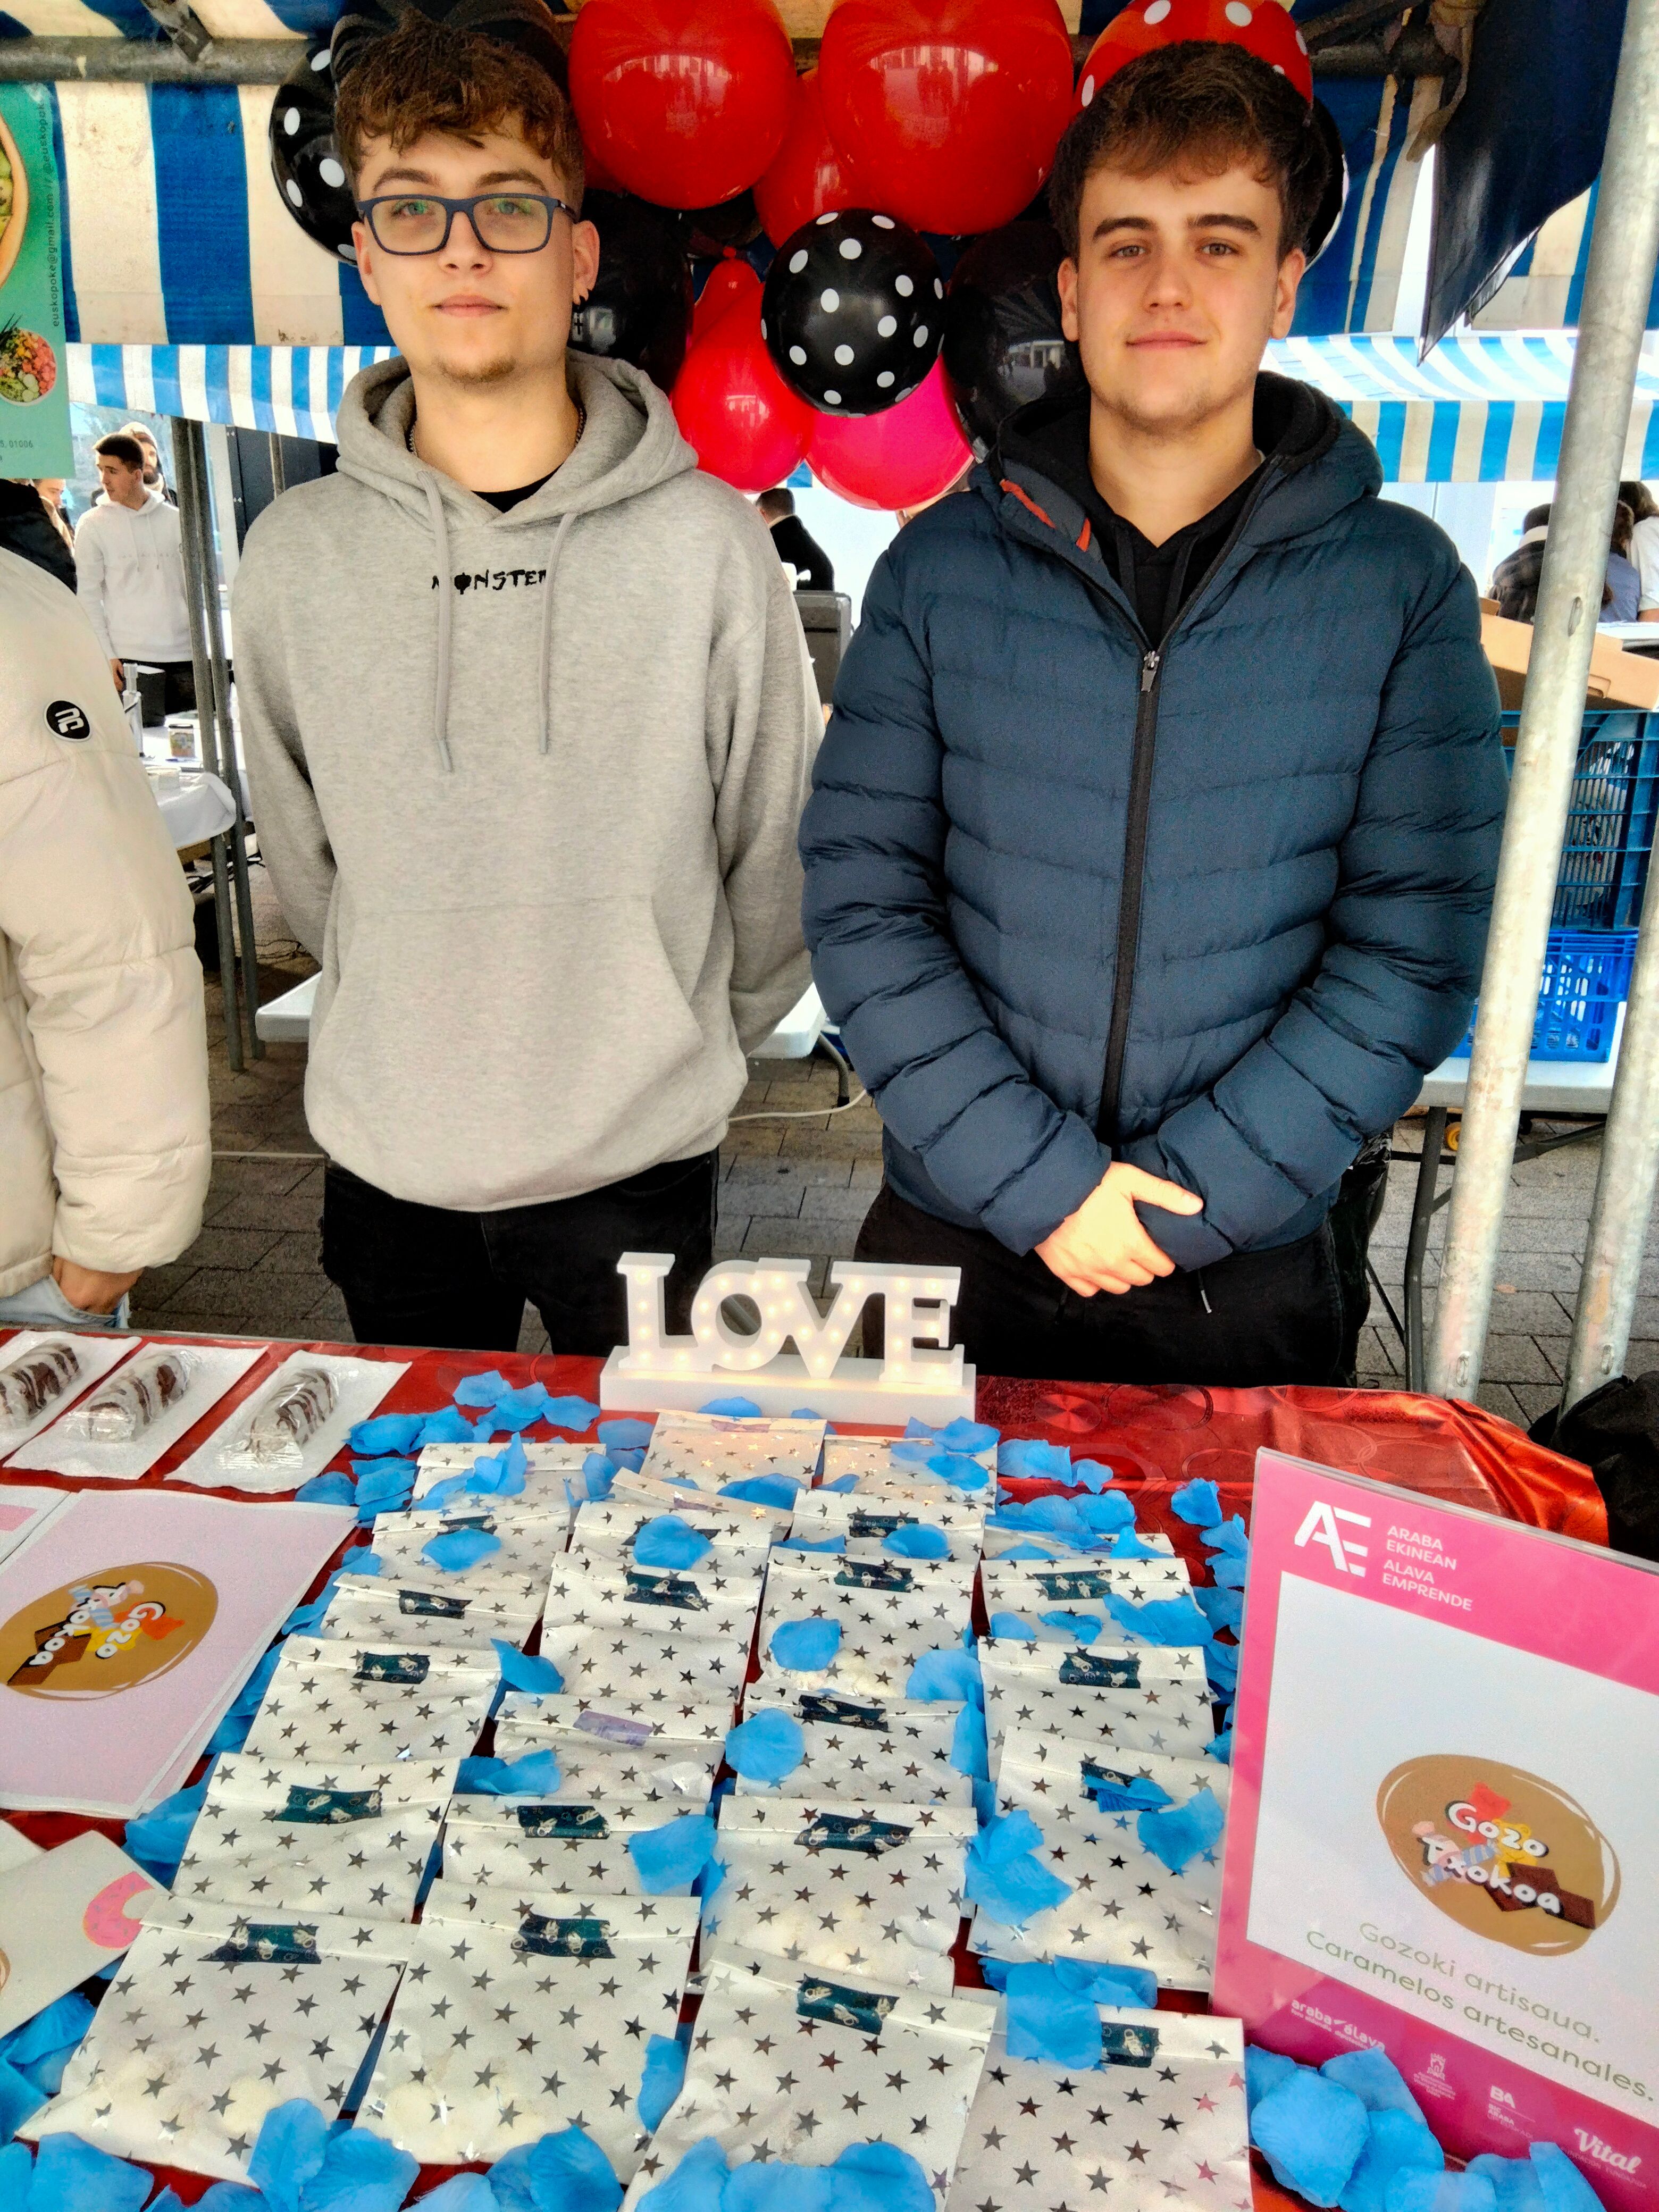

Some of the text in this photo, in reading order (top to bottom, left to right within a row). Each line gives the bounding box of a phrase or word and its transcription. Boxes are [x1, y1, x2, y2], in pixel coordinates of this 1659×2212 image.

[45, 194, 60, 327] euskopoke@gmail.com
[617, 1252, 964, 1386] LOVE
[1386, 1539, 1457, 1570] EKINEAN
[1387, 1526, 1443, 1552] ARABA
[1382, 1572, 1473, 1611] EMPRENDE
[1384, 1560, 1435, 1584] ALAVA
[1359, 1922, 1599, 2043] Gozoki artisaua.
[1291, 1999, 1332, 2025] araba
[1306, 1931, 1654, 2101] Caramelos artesanales.
[1490, 2085, 1515, 2109] BA
[1573, 2128, 1642, 2174] Vital
